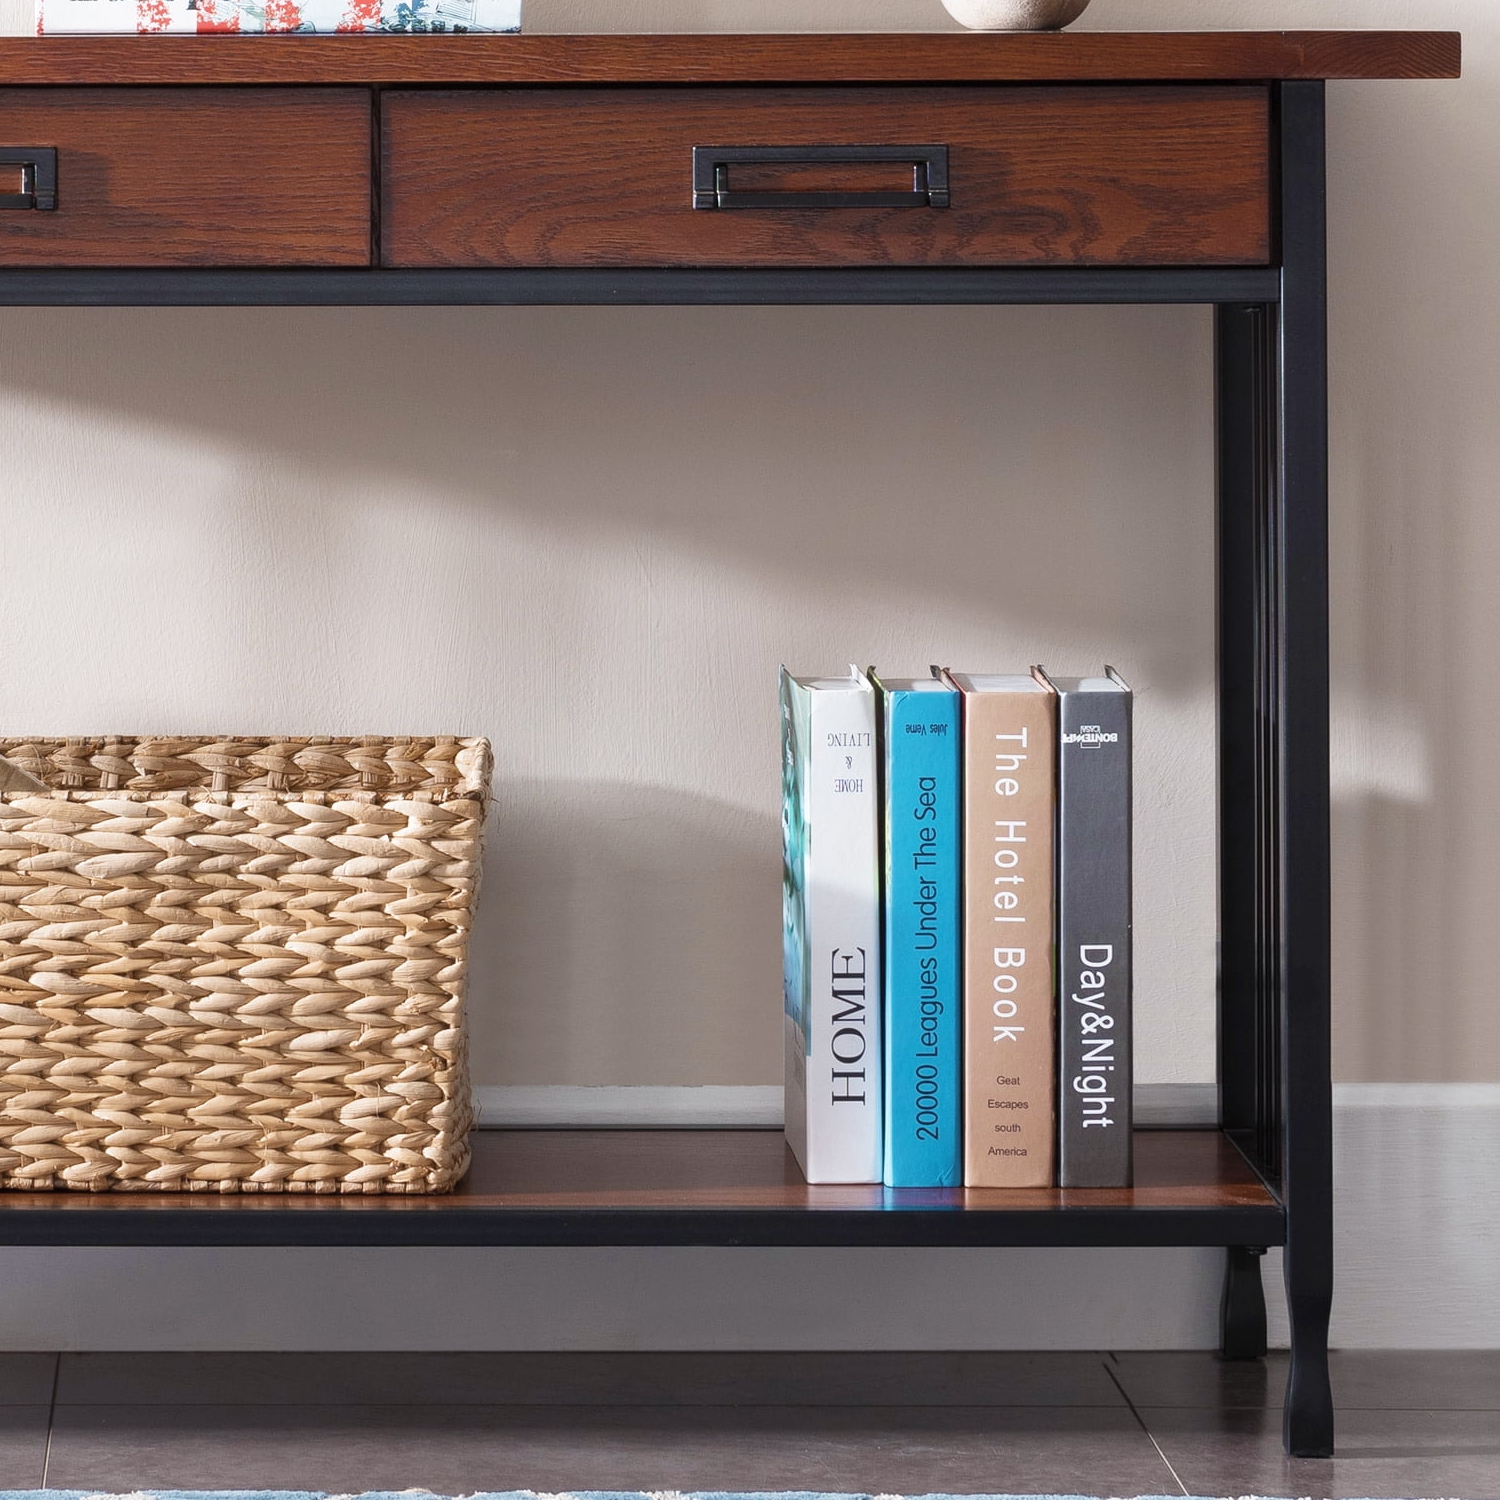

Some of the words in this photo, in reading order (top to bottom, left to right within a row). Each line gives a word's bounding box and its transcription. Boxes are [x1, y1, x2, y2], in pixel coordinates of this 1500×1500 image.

[827, 732, 871, 747] LIVING
[905, 723, 926, 736] Verne
[930, 723, 949, 736] Jules
[845, 756, 853, 770] &
[994, 726, 1028, 797] The
[834, 778, 863, 793] HOME
[914, 776, 937, 821] Sea
[912, 828, 937, 870] The
[994, 820, 1027, 923] Hotel
[913, 877, 938, 951] Under
[915, 957, 943, 1058] Leagues
[993, 947, 1026, 1043] Book
[831, 946, 866, 1107] HOME
[1072, 944, 1115, 1129] Day&Night
[915, 1064, 939, 1141] 20000
[987, 1099, 1029, 1111] Escapes
[994, 1123, 1021, 1133] south
[987, 1146, 1028, 1157] America
